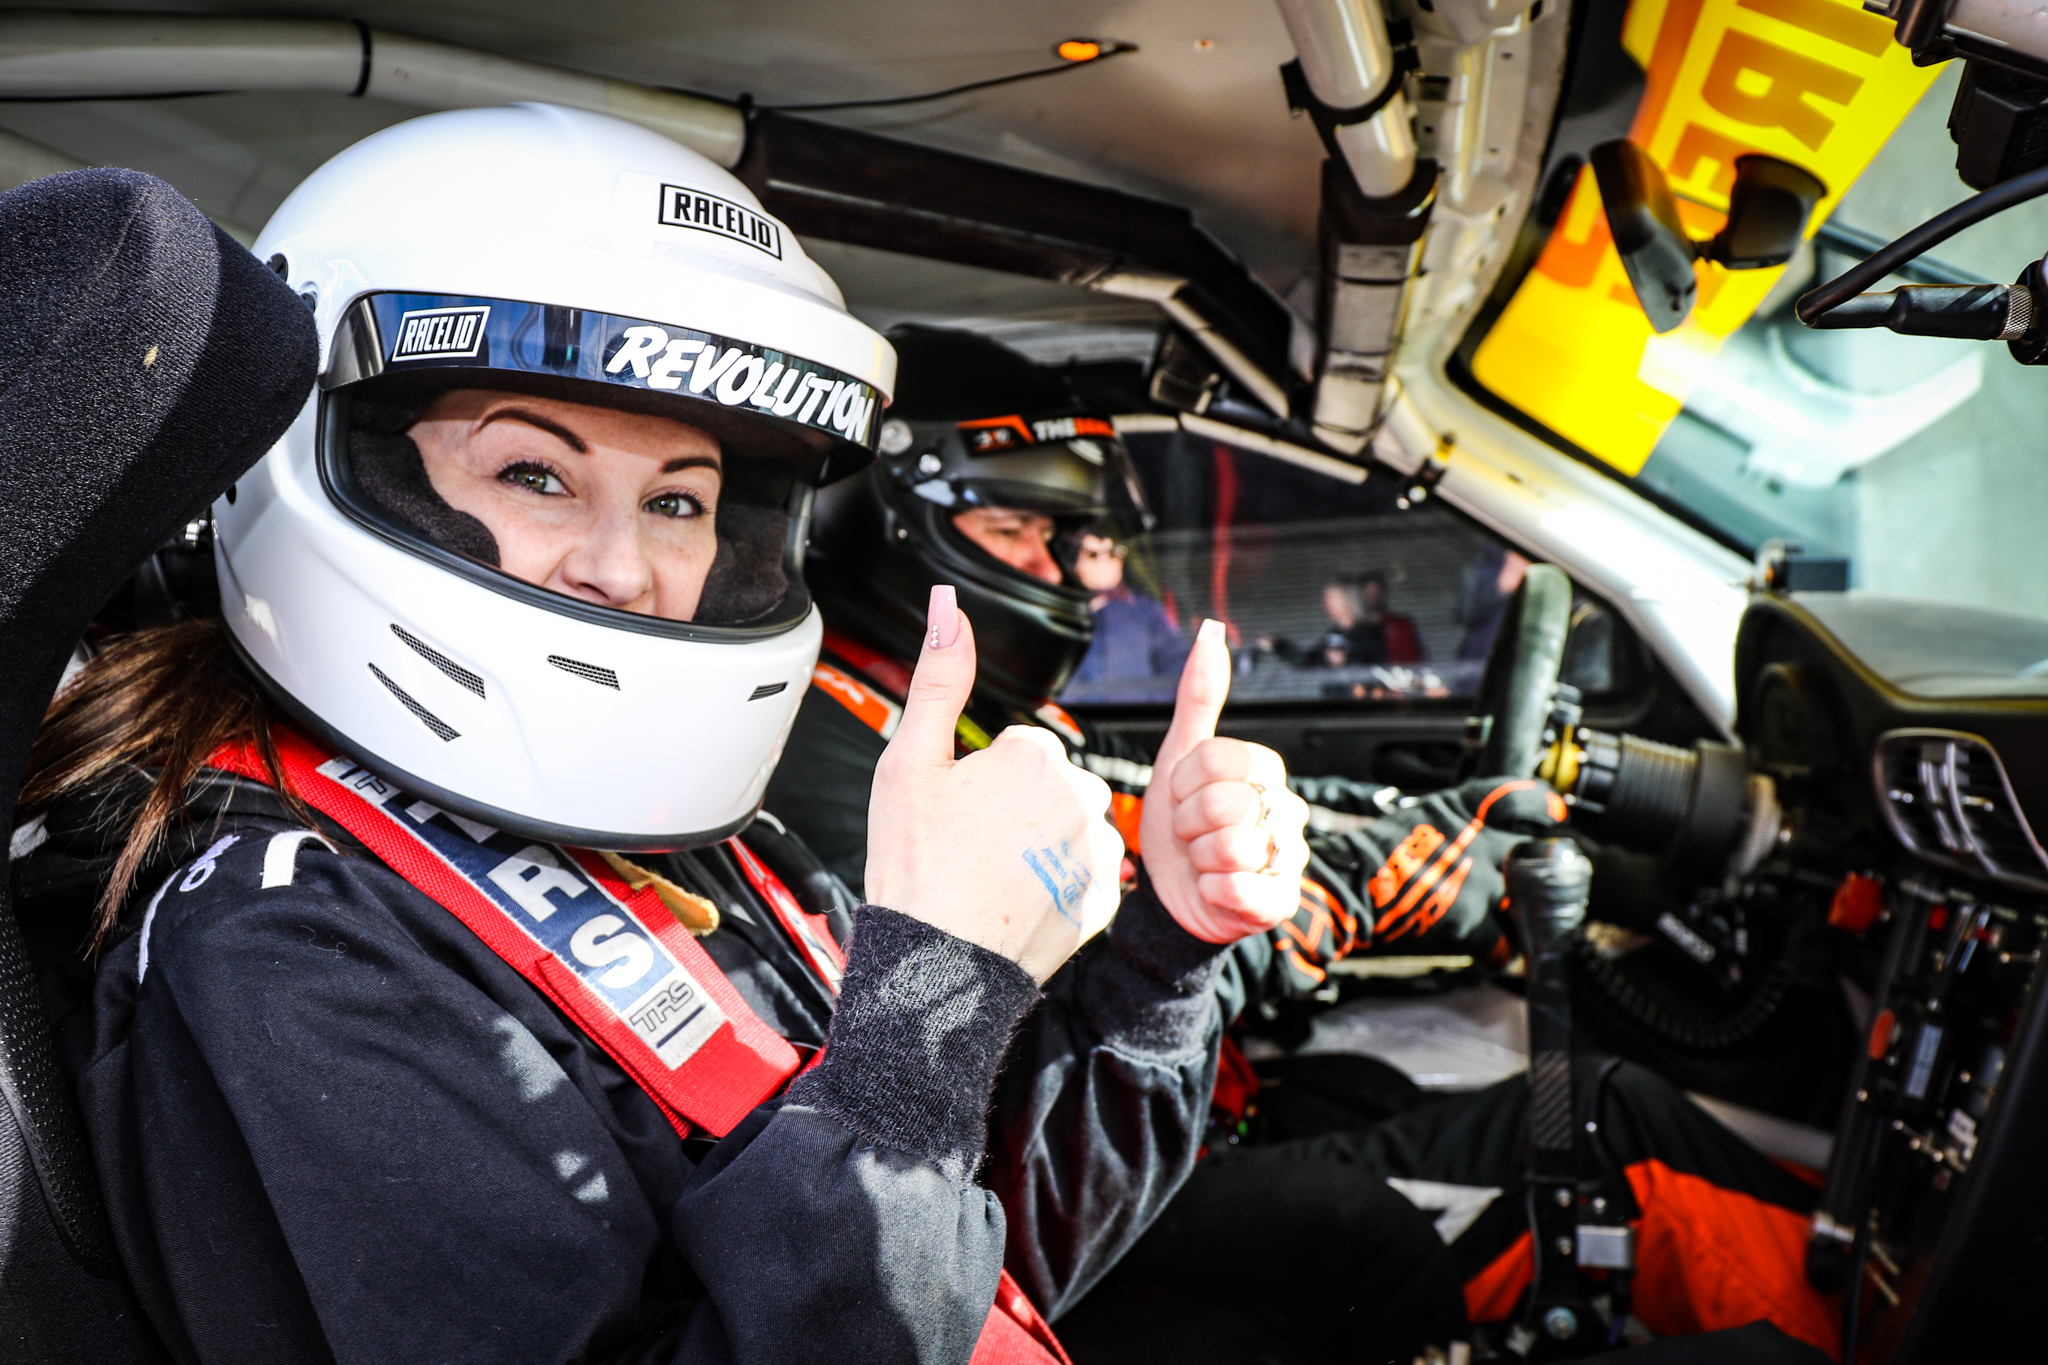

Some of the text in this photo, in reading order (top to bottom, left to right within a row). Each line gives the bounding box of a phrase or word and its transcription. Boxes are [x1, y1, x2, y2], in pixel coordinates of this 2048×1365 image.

[674, 192, 771, 248] RACELID
[401, 315, 477, 353] RACELID
[606, 326, 874, 441] REVOLUTION
[629, 979, 694, 1032] TRS
